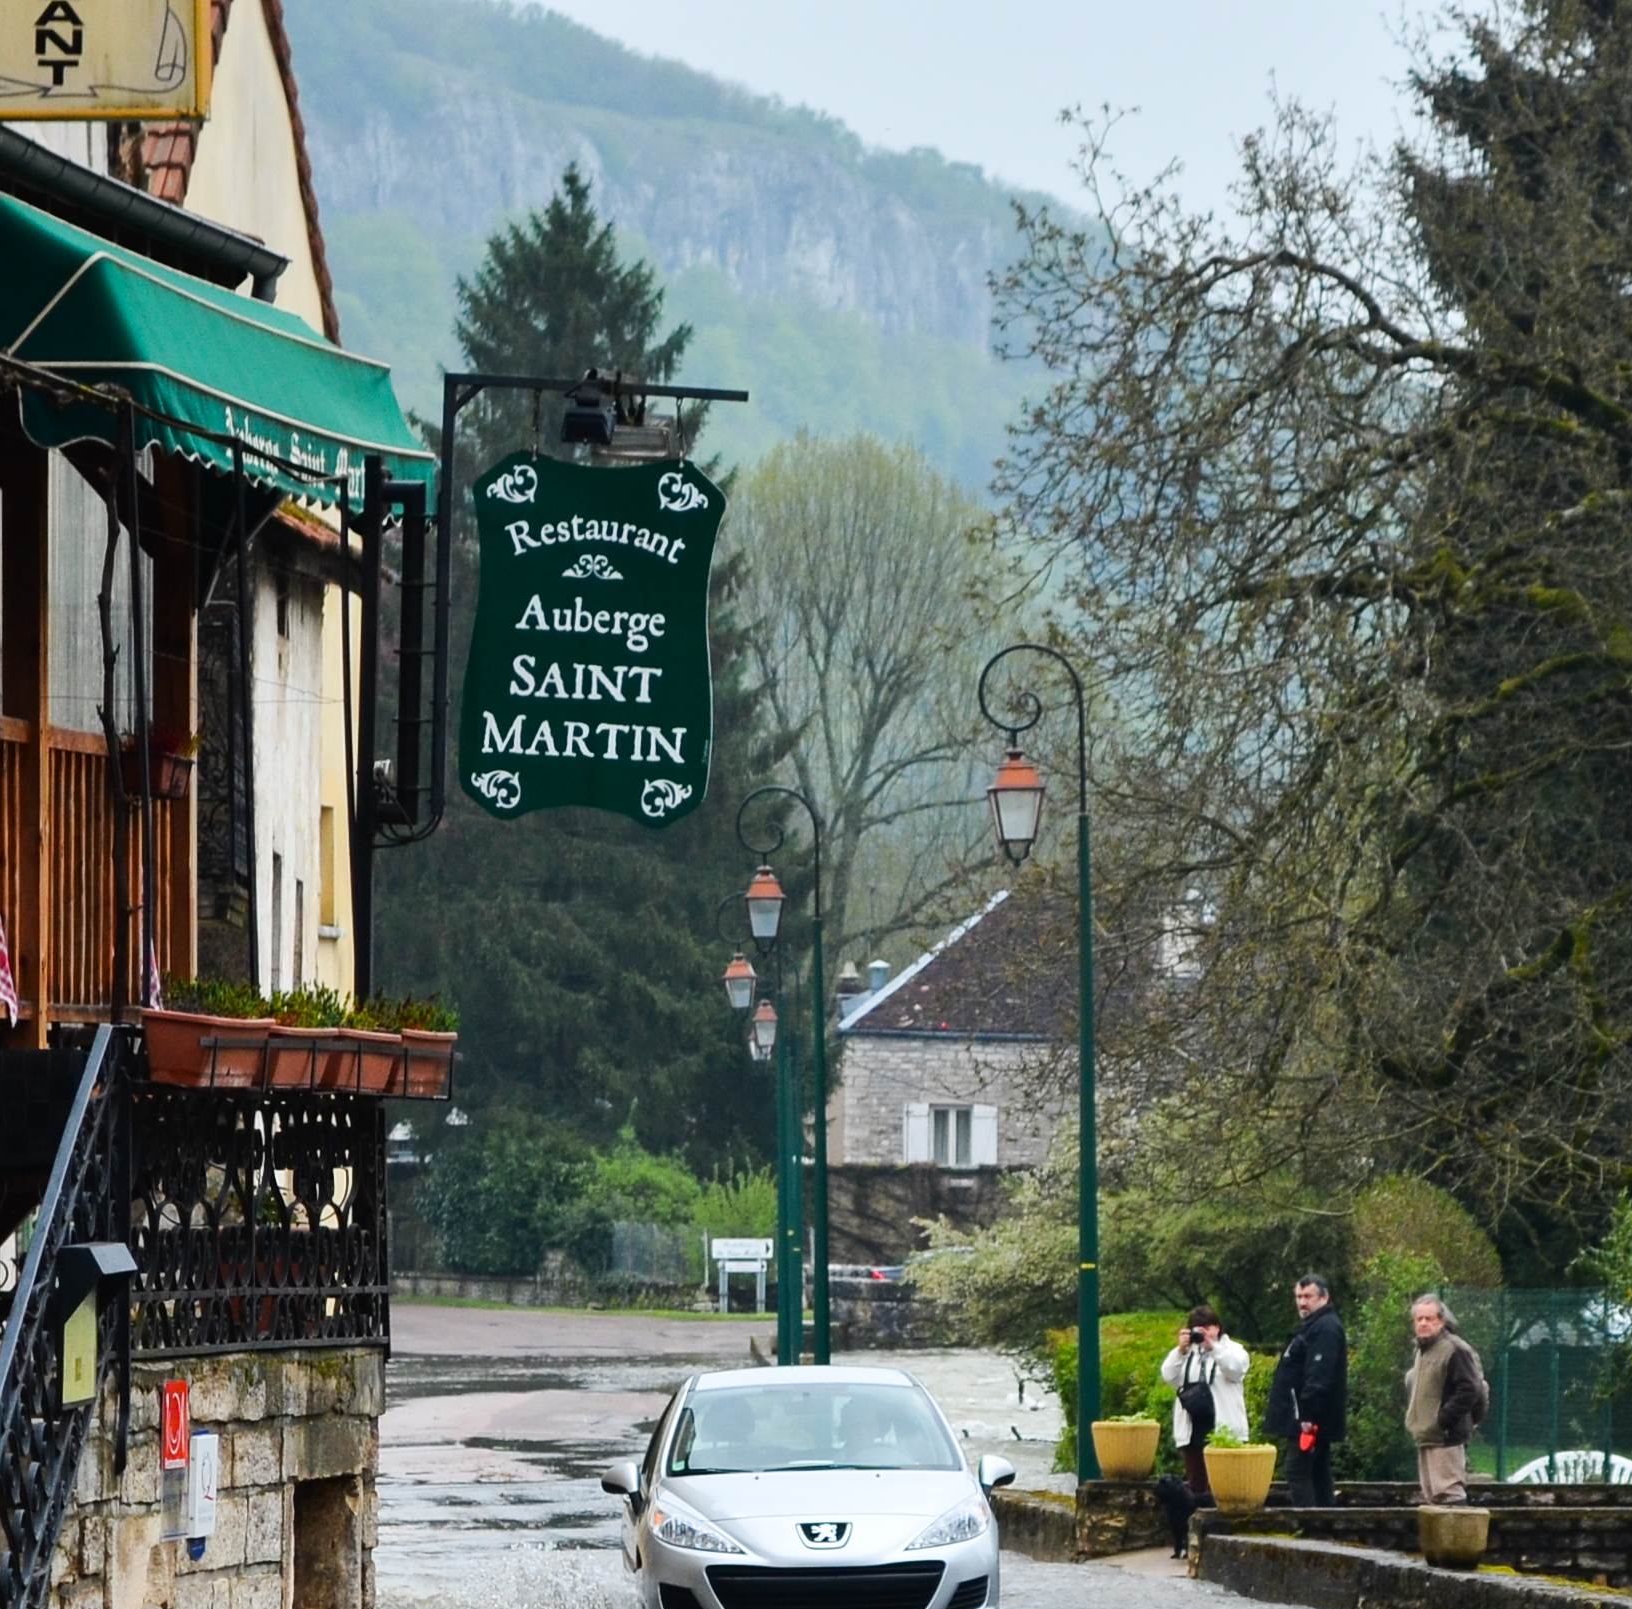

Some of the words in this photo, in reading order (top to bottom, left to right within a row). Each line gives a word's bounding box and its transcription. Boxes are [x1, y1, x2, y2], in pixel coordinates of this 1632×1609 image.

[334, 446, 366, 500] Mart
[504, 513, 686, 564] Restaurant
[515, 594, 666, 653] Auberge
[509, 654, 663, 703] SAINT
[481, 710, 688, 764] MARTIN
